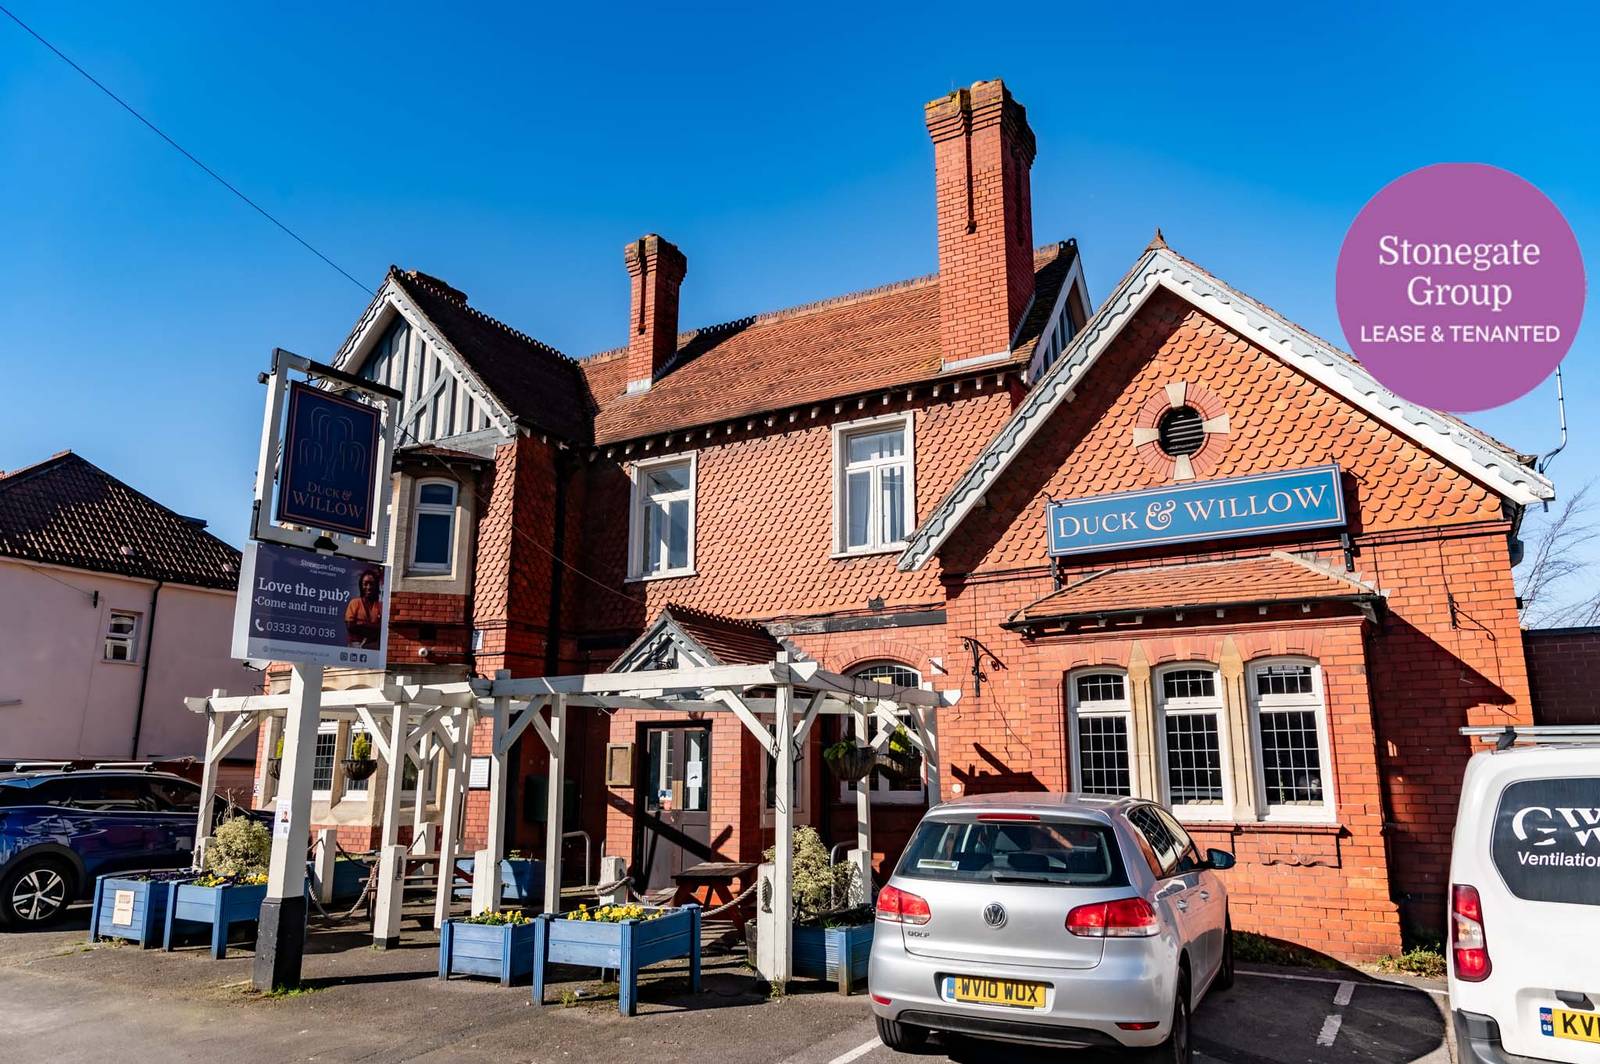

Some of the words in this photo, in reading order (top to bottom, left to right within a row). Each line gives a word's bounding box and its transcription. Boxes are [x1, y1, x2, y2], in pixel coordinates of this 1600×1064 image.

[293, 489, 364, 519] WILLOW
[307, 481, 340, 499] DUCK
[341, 487, 353, 502] &
[1058, 511, 1138, 538] DUCK
[1145, 500, 1176, 531] &
[1184, 484, 1327, 523] WILLOW
[258, 577, 292, 594] Love
[295, 582, 316, 598] the
[318, 587, 350, 603] pub?
[257, 595, 287, 609] Come
[288, 600, 308, 612] and
[309, 606, 327, 615] run
[328, 605, 339, 616] it!
[266, 621, 297, 634] 03333
[299, 625, 317, 636] 200
[318, 627, 336, 639] 036
[961, 977, 999, 998] WV10
[1004, 982, 1038, 1002] WUX
[1562, 1012, 1600, 1038] KV
